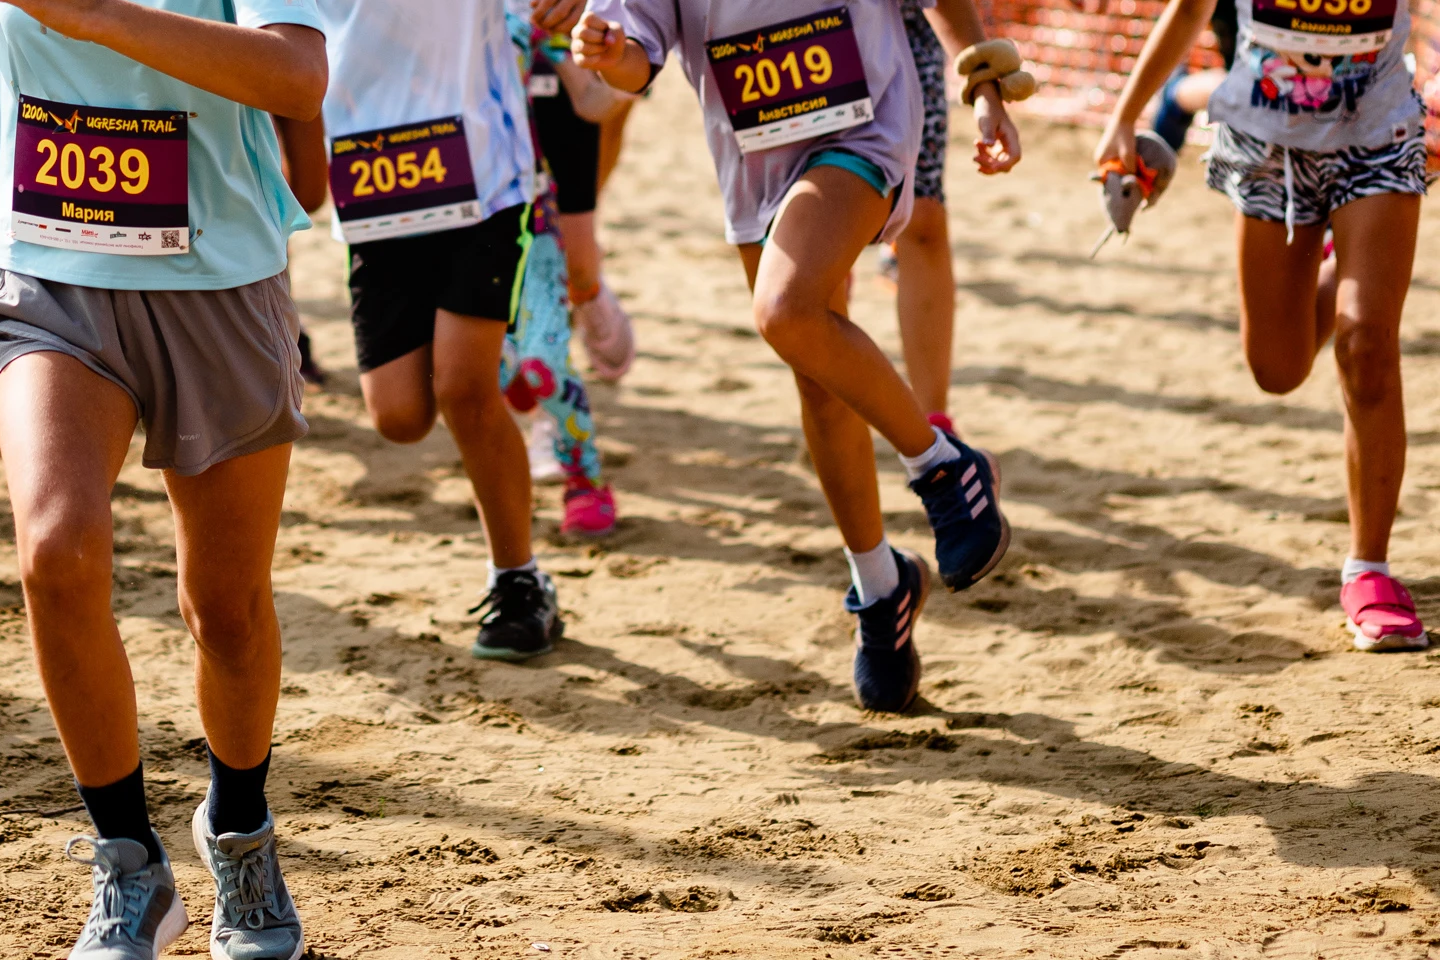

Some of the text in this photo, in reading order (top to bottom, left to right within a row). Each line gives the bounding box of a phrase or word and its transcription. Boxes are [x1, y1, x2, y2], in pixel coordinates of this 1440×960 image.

[734, 45, 833, 104] 2019
[86, 116, 139, 132] UGRESHA
[141, 119, 177, 133] TRAIL
[758, 96, 828, 123] Анастасия
[35, 138, 150, 195] 2039
[349, 147, 447, 197] 2054
[62, 201, 115, 223] Мария
